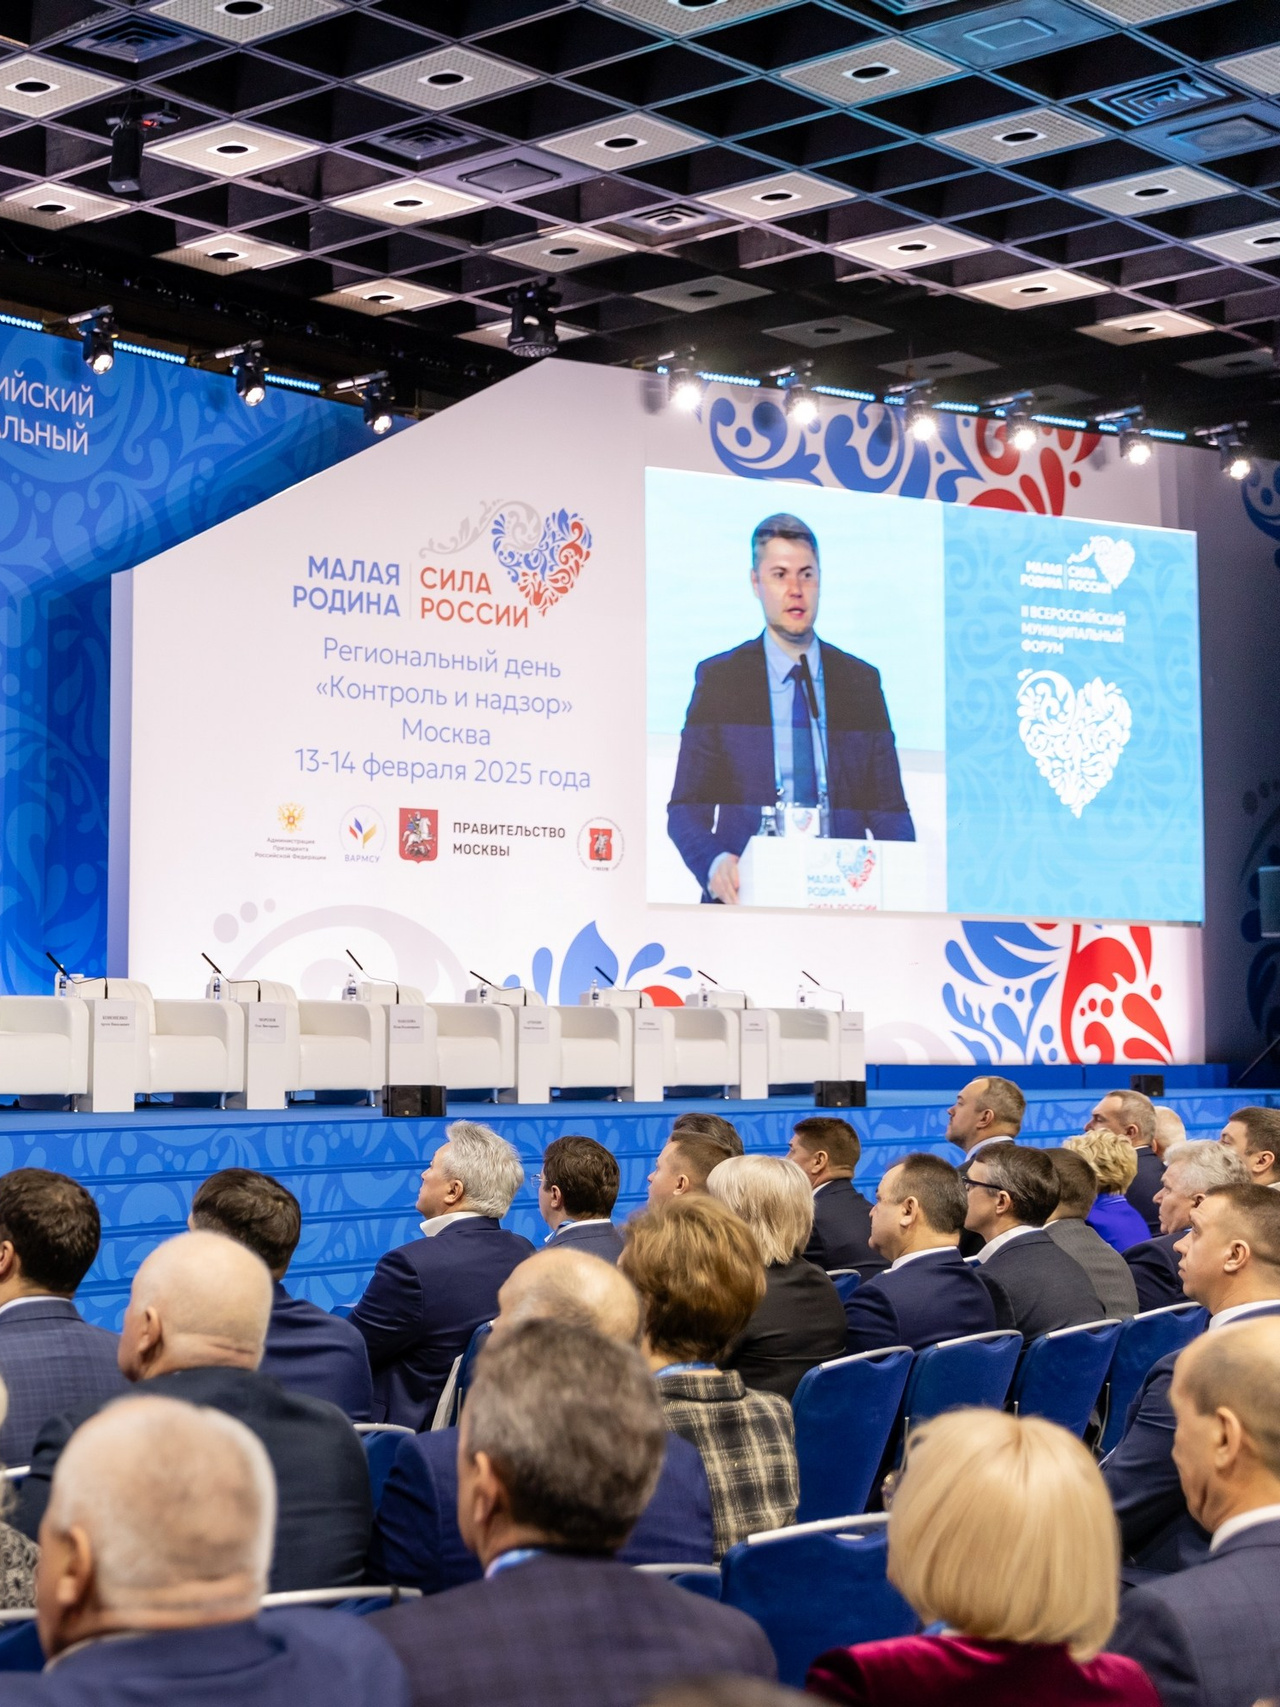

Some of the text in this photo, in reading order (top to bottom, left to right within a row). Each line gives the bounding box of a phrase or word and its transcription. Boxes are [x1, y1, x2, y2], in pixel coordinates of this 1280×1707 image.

[308, 556, 400, 586] МАЛАЯ
[420, 567, 492, 595] СИЛА
[292, 585, 401, 617] РОДИНА
[420, 597, 529, 628] РОССИИ
[1030, 605, 1126, 627] ВСЕРОССИЙСКИЙ
[1021, 622, 1125, 643] МУНИЦИПАЛЬНЫЙ
[323, 637, 561, 678] Региональный день
[1021, 639, 1064, 655] ФОРУМ
[316, 675, 573, 719] «Контроль и надзор»
[402, 718, 491, 745] Москва
[294, 748, 591, 791] 13-14 февраля 2025 года
[453, 822, 566, 839] ПРАВИТЕЛЬСТВО
[344, 854, 380, 863] ВАРМСУ
[453, 843, 510, 857] МОСКВЫ
